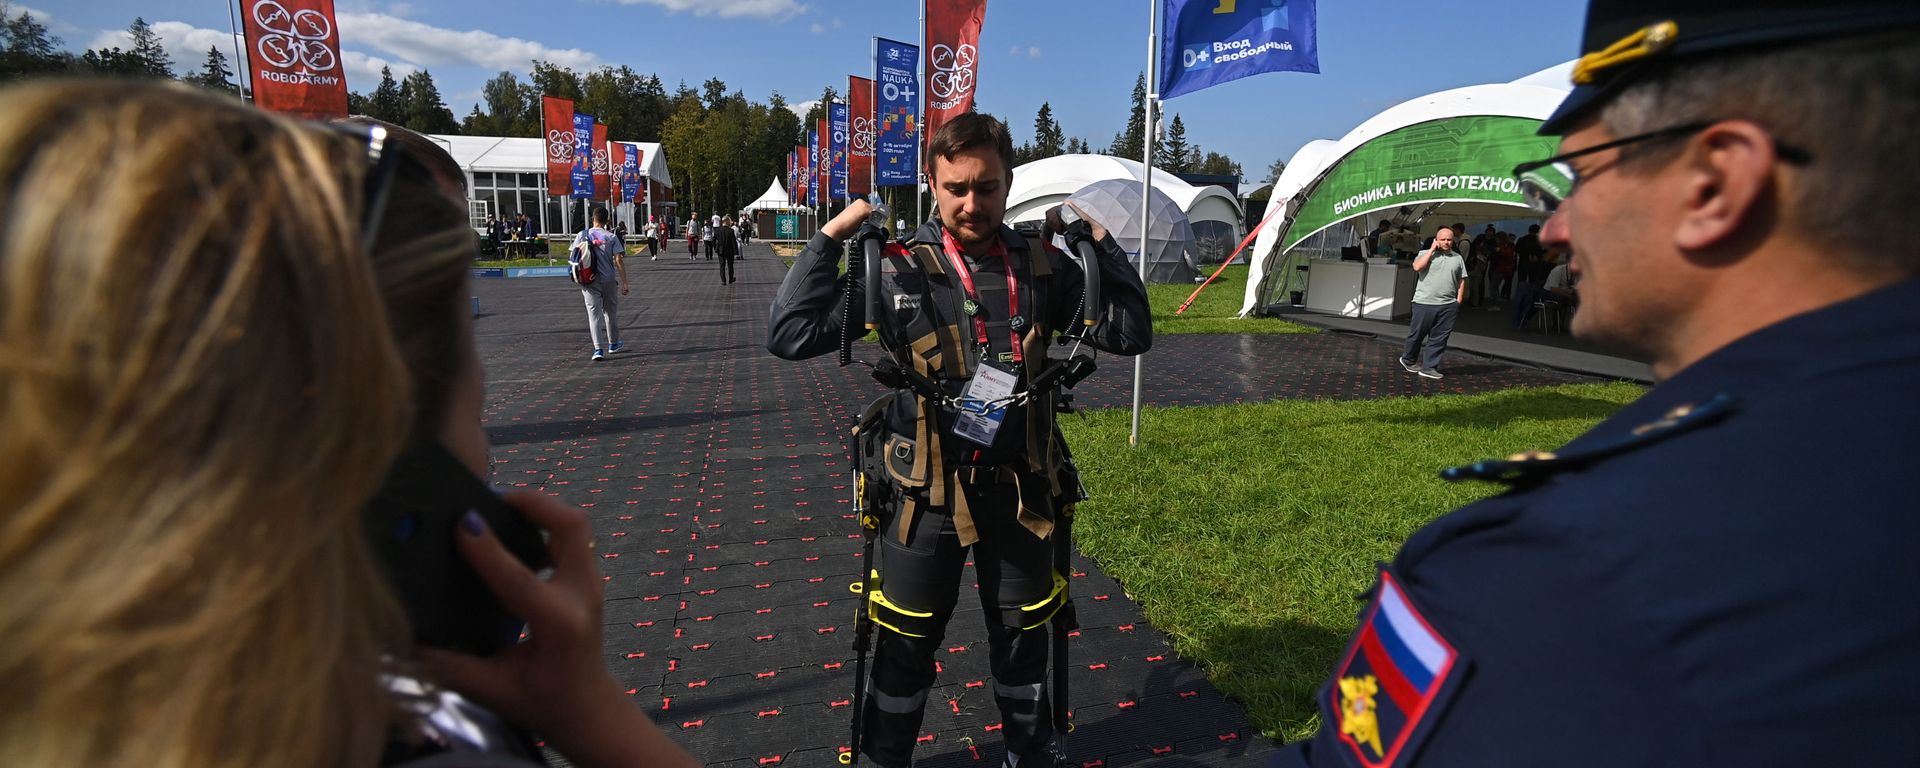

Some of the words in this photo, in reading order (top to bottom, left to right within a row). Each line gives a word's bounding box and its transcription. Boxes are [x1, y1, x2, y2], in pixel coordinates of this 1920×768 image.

[1213, 38, 1251, 53] Вход
[1214, 41, 1293, 64] свободный
[1183, 48, 1210, 68] 0+
[261, 66, 338, 85] ROBOARMY
[882, 73, 914, 84] NAUKA
[883, 83, 915, 102] 0+
[1334, 185, 1393, 215] БИОНИКА
[1396, 182, 1405, 195] И
